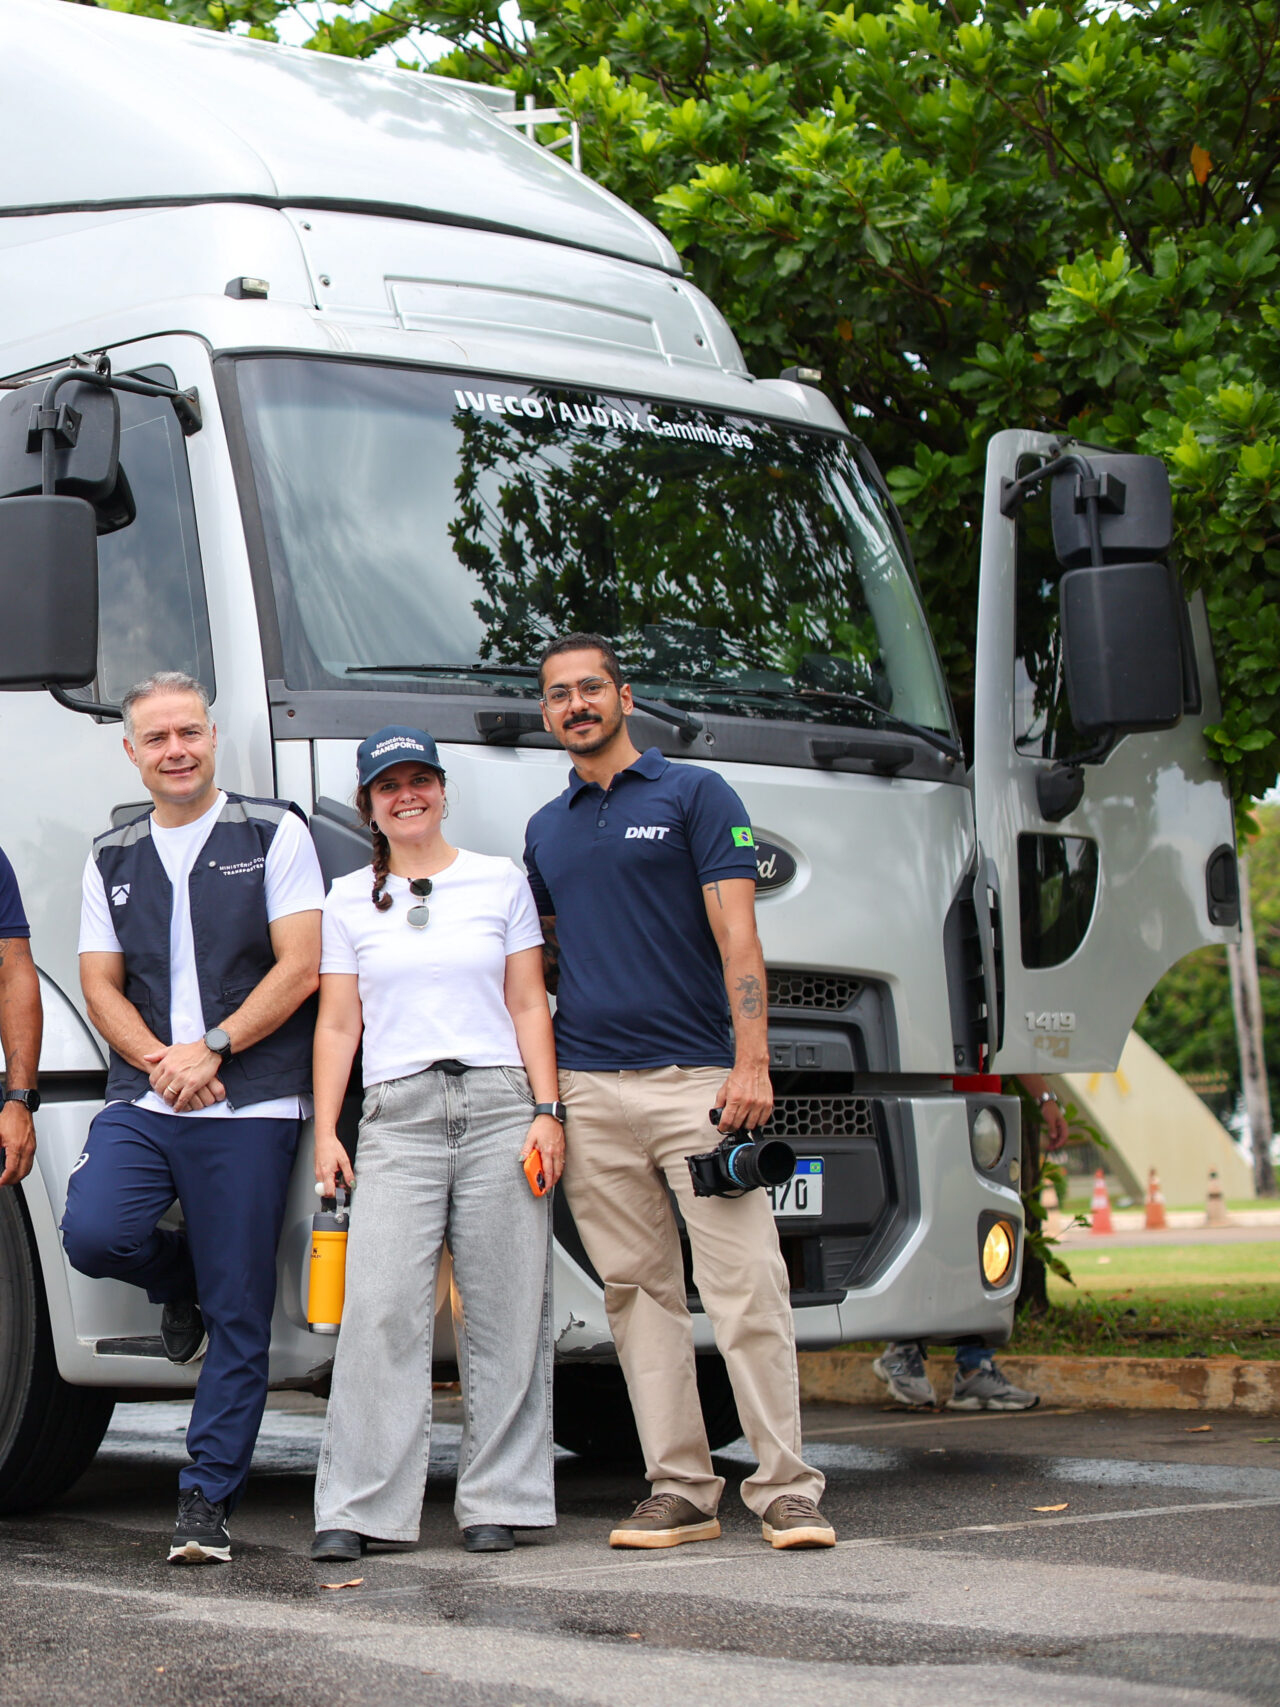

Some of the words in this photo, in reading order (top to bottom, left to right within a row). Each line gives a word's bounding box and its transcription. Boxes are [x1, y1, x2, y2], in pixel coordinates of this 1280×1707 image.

[454, 390, 544, 419] IVECO
[559, 402, 646, 433] AUDAX
[647, 415, 754, 450] Caminhões
[370, 741, 425, 758] TRANSPORTES
[624, 826, 670, 840] DNIT
[1025, 1011, 1076, 1032] 1419
